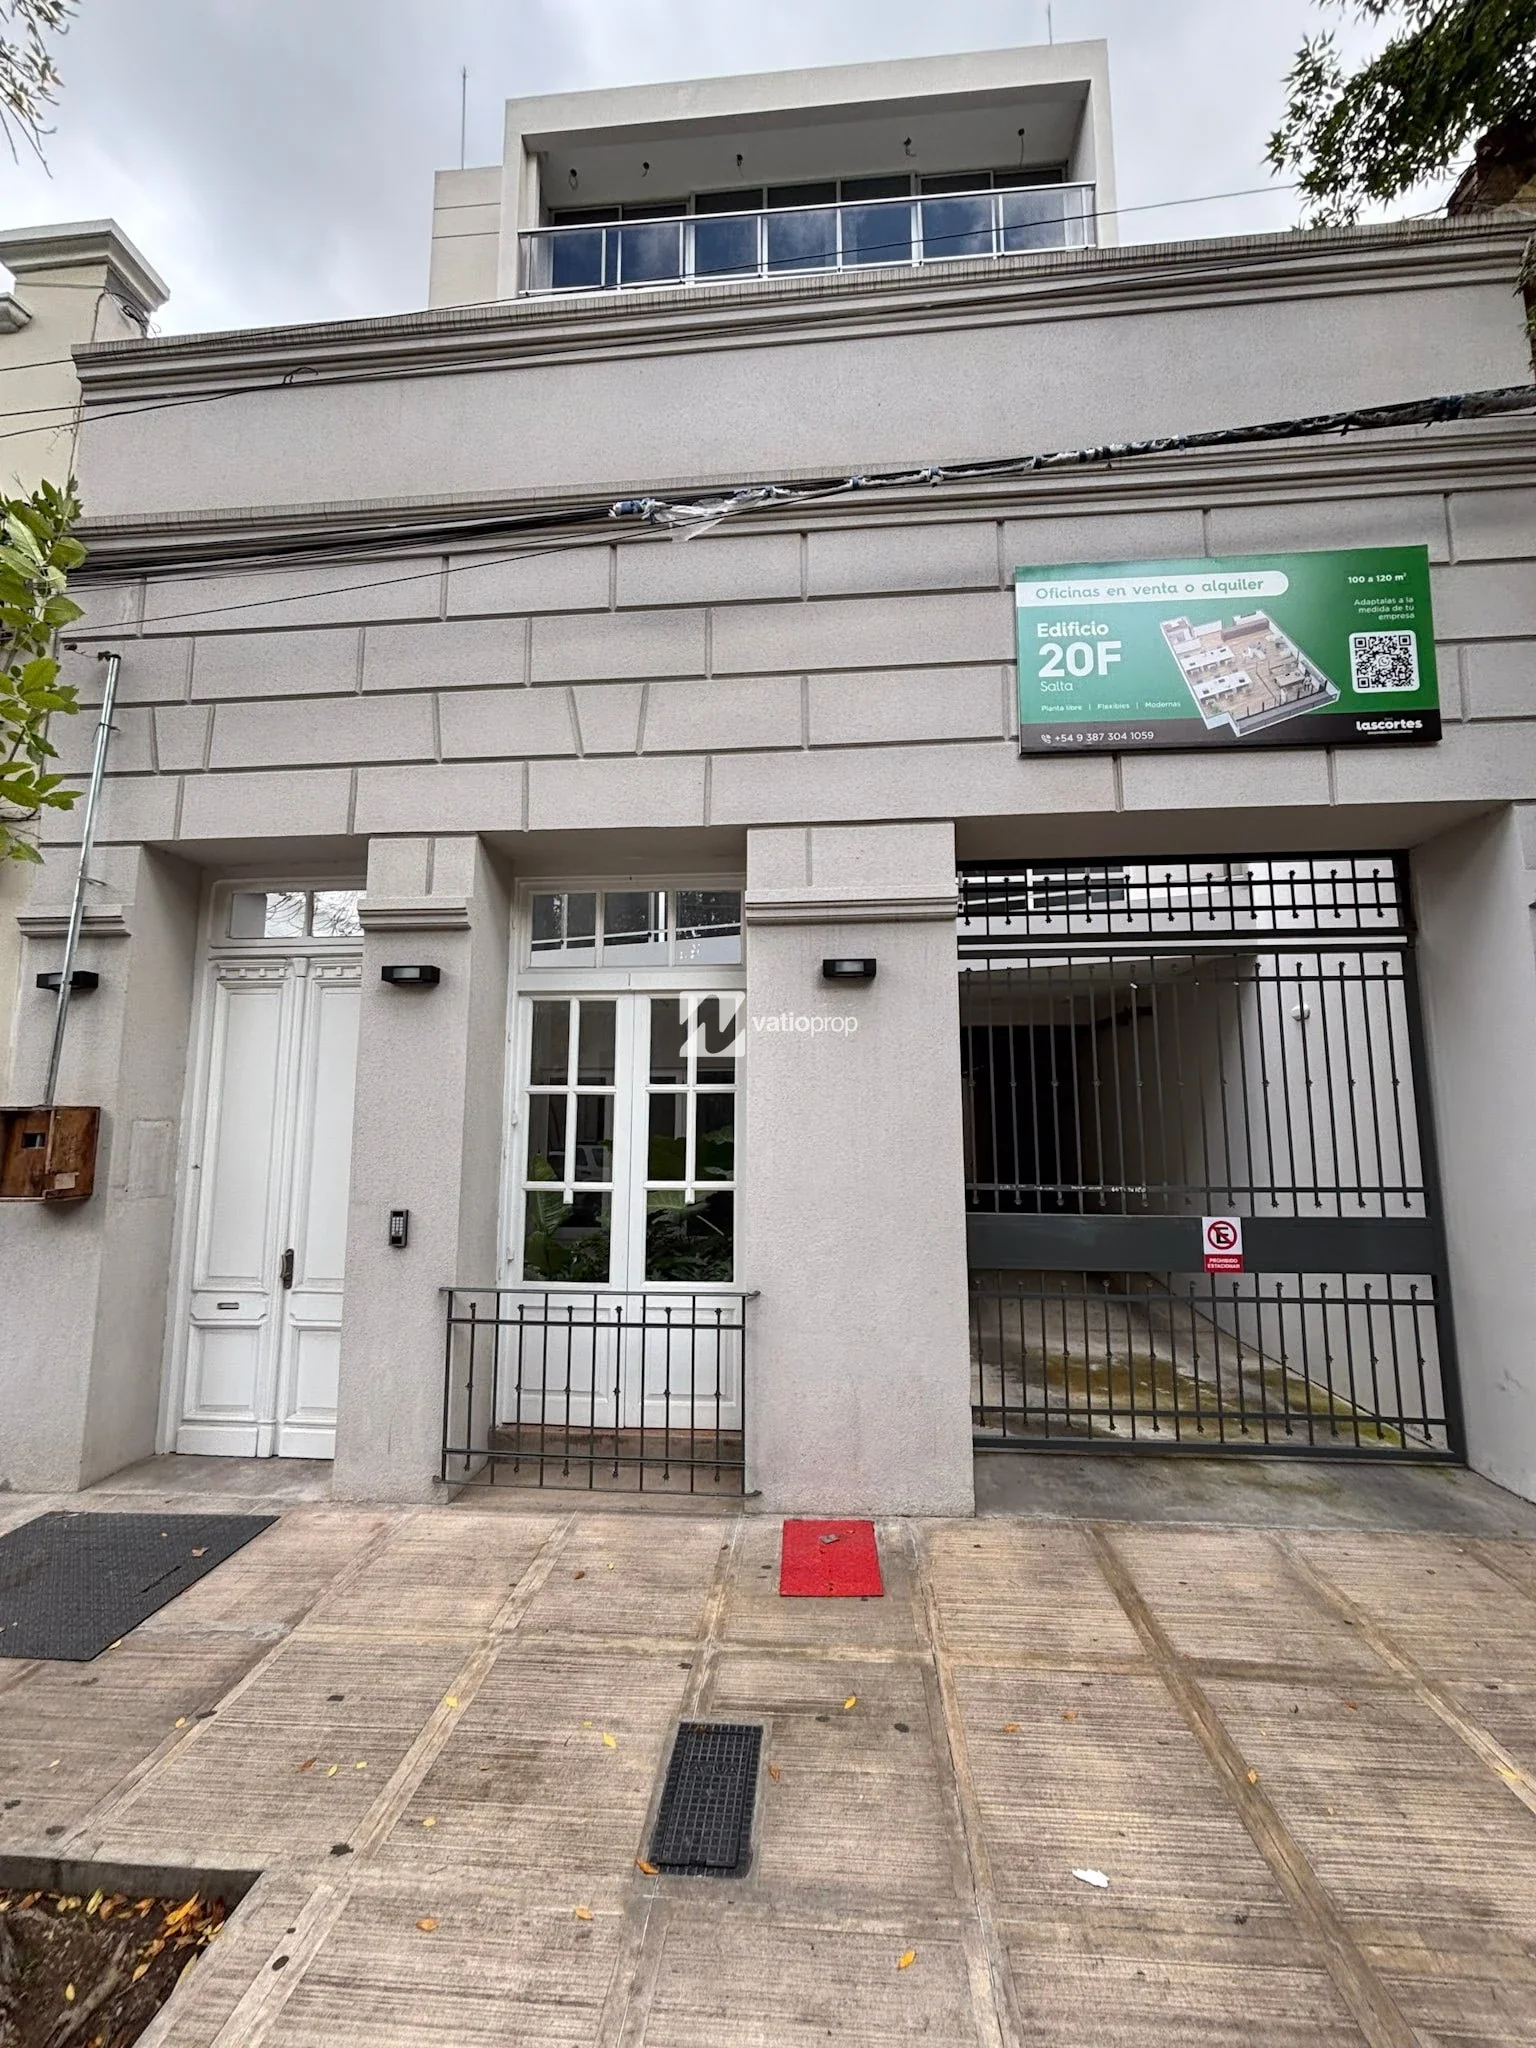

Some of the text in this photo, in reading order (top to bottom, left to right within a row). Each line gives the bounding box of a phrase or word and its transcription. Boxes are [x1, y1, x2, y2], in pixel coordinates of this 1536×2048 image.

[1348, 575, 1365, 584] 100
[1375, 574, 1393, 582] 120
[1035, 577, 1264, 600] Oficinas en venta o alquiler
[1358, 605, 1390, 614] medida
[1378, 612, 1415, 621] empresa
[1037, 621, 1110, 638] Edificio
[1038, 640, 1122, 678] 20F
[1040, 680, 1073, 692] Salta
[1041, 703, 1083, 712] Planta libre
[1097, 702, 1130, 711] Flexibles
[1145, 700, 1181, 709] Modernas
[1355, 719, 1423, 731] lascortes
[1055, 730, 1154, 743] +54 9 387 304 1059
